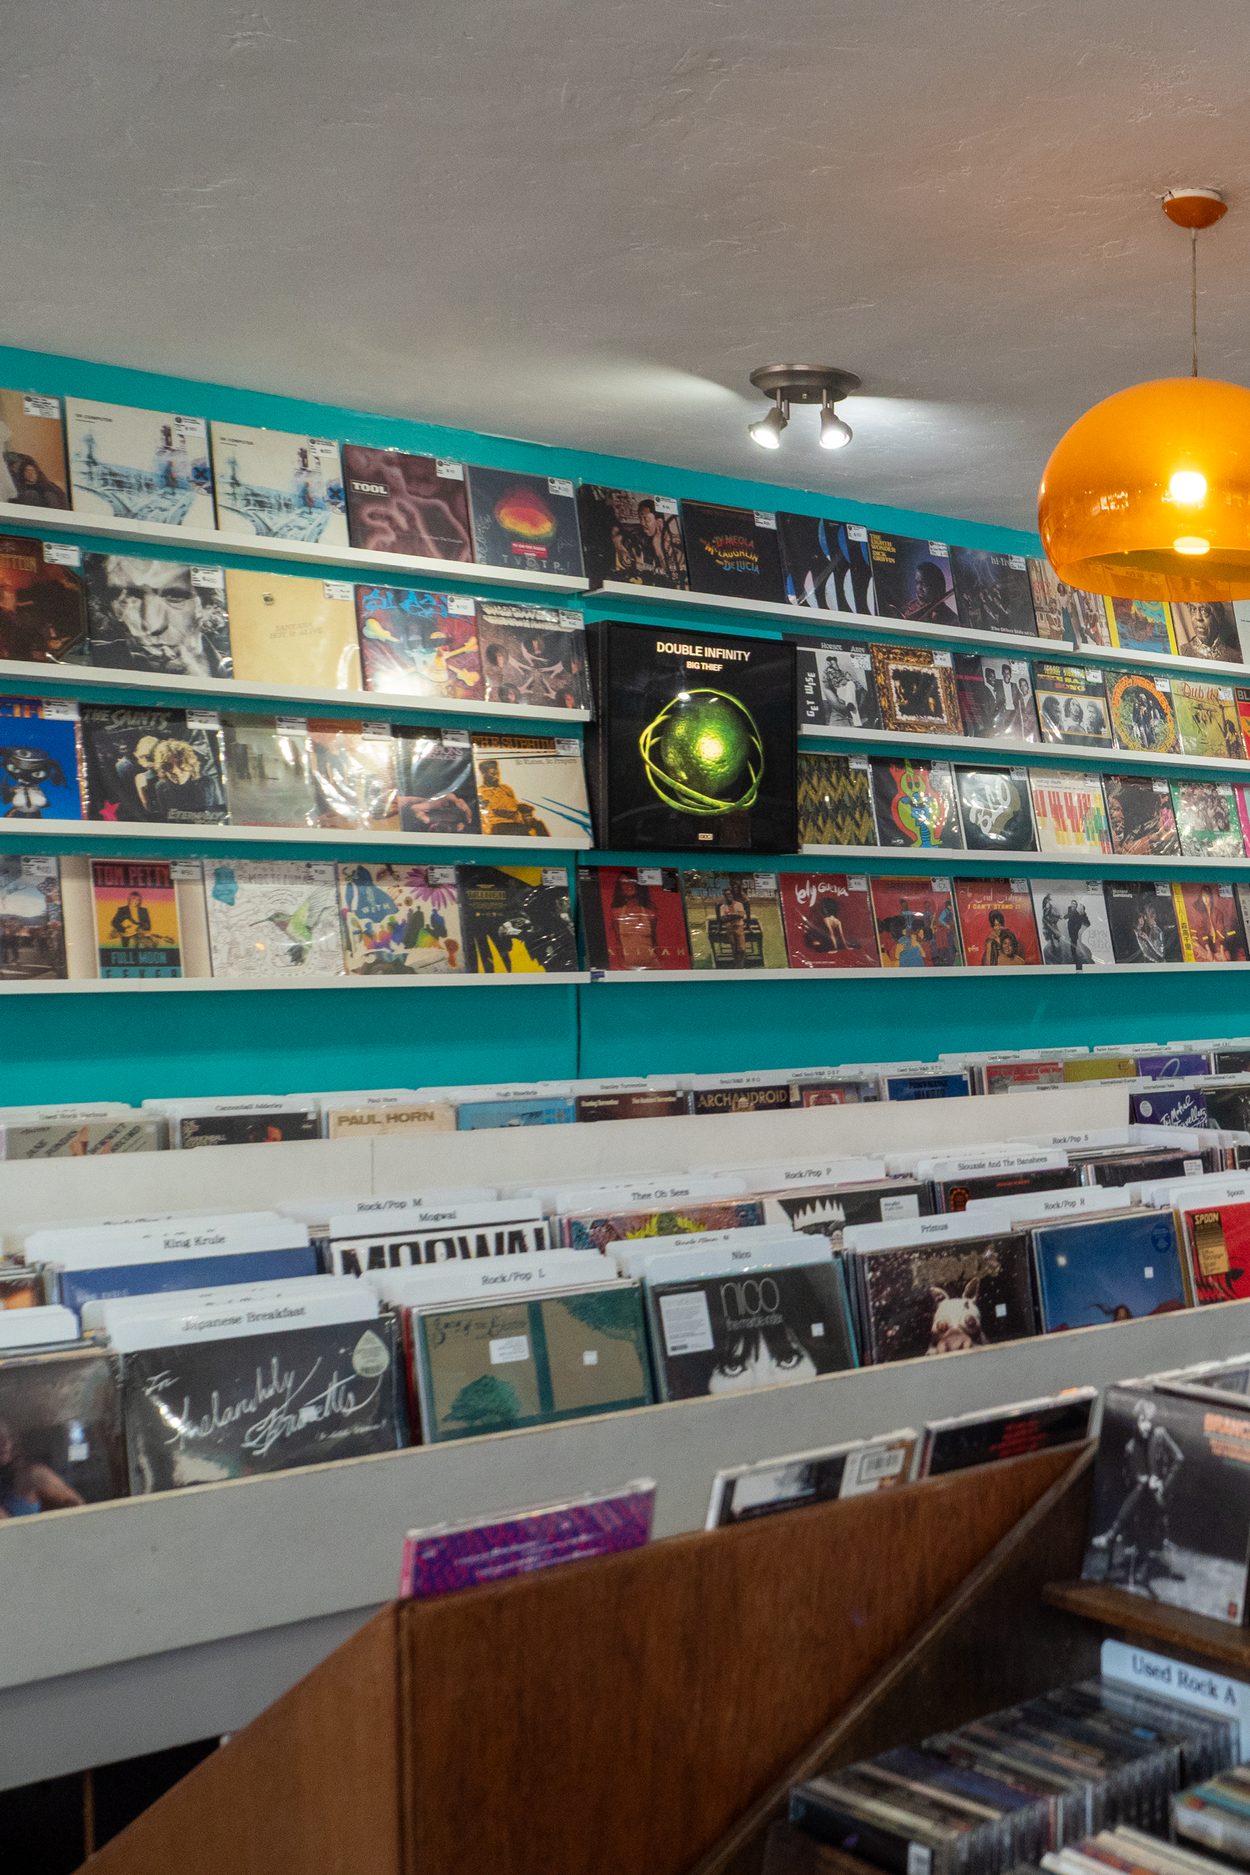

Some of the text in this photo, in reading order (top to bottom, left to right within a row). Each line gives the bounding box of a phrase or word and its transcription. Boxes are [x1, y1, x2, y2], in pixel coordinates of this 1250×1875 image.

[352, 482, 388, 495] TOOL
[872, 545, 896, 553] WONDER
[656, 642, 751, 661] DOUBLE INFINITY
[686, 661, 723, 671] BIG THIEF
[804, 672, 820, 718] GET WISE
[105, 709, 172, 733] SAINTS
[475, 736, 500, 748] THE
[361, 902, 391, 913] WITH
[110, 951, 167, 965] FULL MOON
[697, 1089, 788, 1109] ARCHANDROID
[215, 1101, 283, 1112] Cannonball Adderley
[337, 1110, 435, 1127] PAUL HORN
[1052, 1136, 1082, 1145] Rock/Pop
[987, 1159, 1002, 1169] And
[1002, 1158, 1016, 1167] The
[1016, 1156, 1049, 1166] Banshees
[784, 1169, 823, 1181] Rock/Pop
[631, 1188, 690, 1202] Thee Oh Sees
[1226, 1188, 1246, 1199] Spoon
[357, 1198, 423, 1213] Rock/Pop M
[1043, 1199, 1078, 1211] Rock/Pop
[418, 1209, 458, 1222] Mogwai
[1193, 1210, 1220, 1226] SPOON
[921, 1222, 949, 1234] Primus
[163, 1234, 227, 1250] King Krule
[731, 1251, 752, 1260] Nico
[481, 1268, 547, 1287] Rock/Pop L
[182, 1305, 307, 1333] Japanese Breakfast
[1131, 1652, 1239, 1708] Used Rock A
